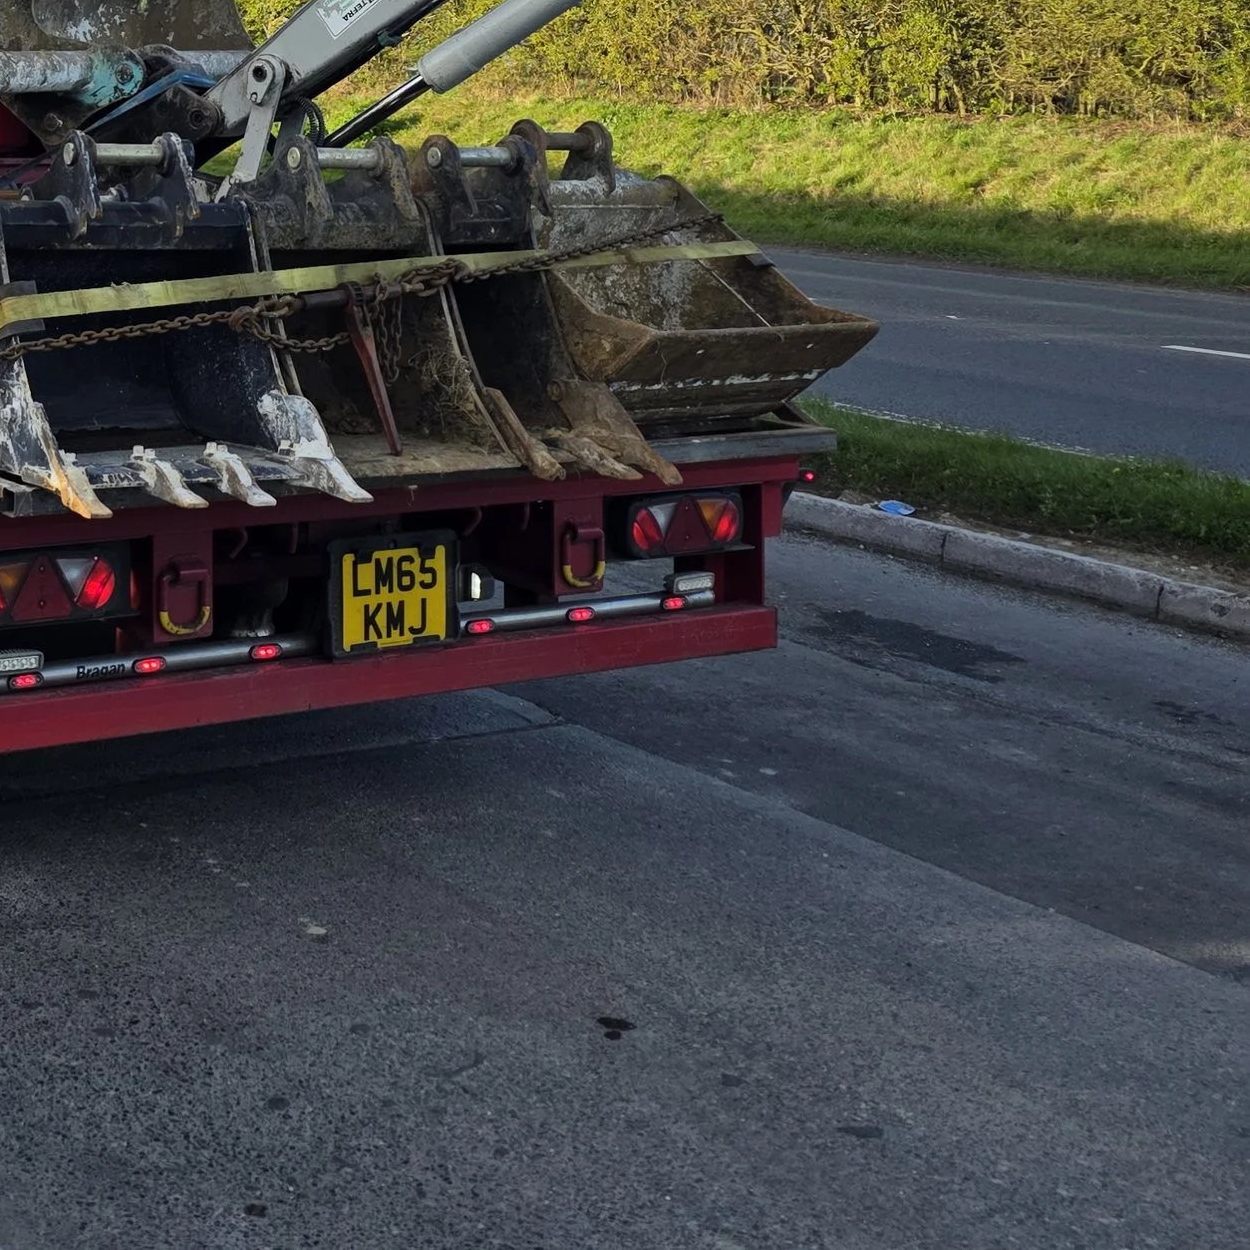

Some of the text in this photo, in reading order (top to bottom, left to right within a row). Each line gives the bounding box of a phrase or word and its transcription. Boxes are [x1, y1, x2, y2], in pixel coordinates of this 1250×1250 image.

[352, 555, 437, 597] LM65
[363, 598, 427, 641] KMJ
[76, 662, 126, 679] Bragan
